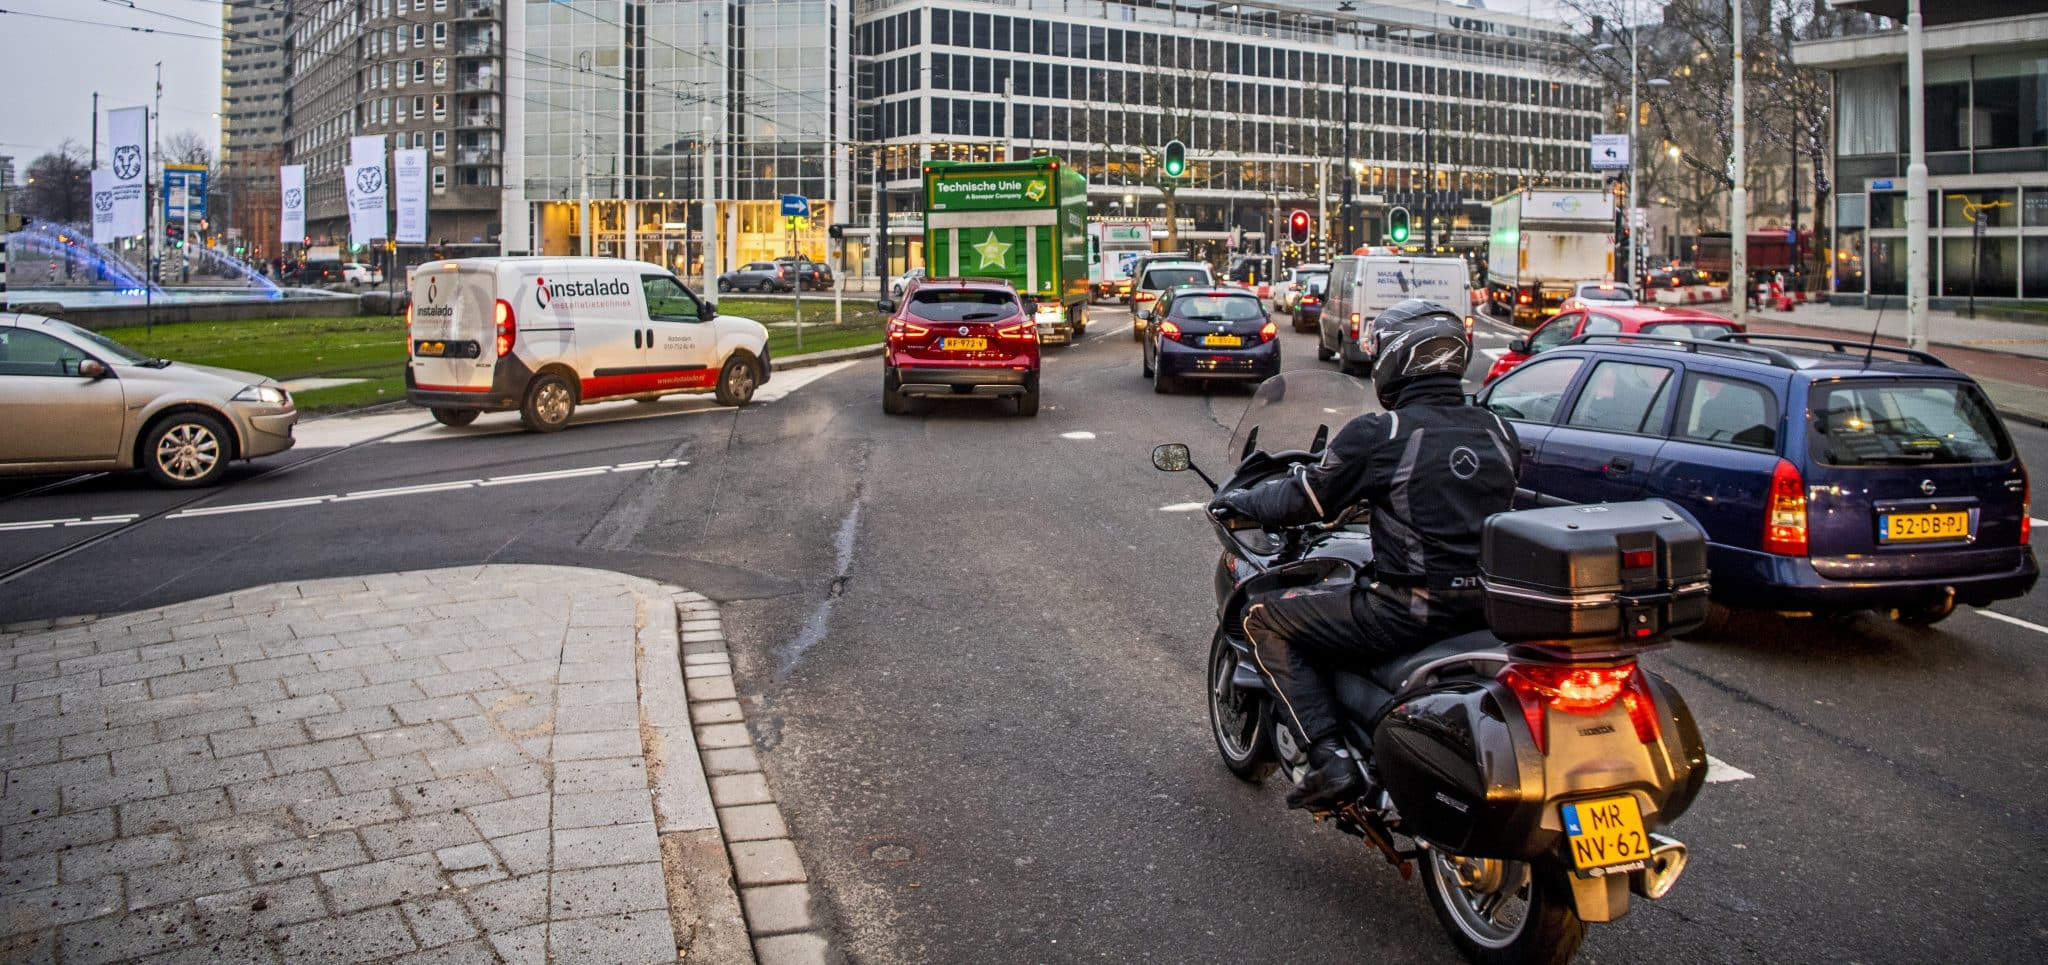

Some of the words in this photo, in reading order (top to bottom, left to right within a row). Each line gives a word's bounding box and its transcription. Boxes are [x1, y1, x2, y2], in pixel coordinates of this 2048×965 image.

[937, 180, 996, 192] Technische
[998, 180, 1022, 191] Unie
[549, 278, 630, 297] instalado
[417, 303, 453, 317] instalado
[1896, 516, 1962, 535] 52-DB-PJ
[1590, 804, 1624, 830] MR
[1576, 831, 1645, 864] NV-62
